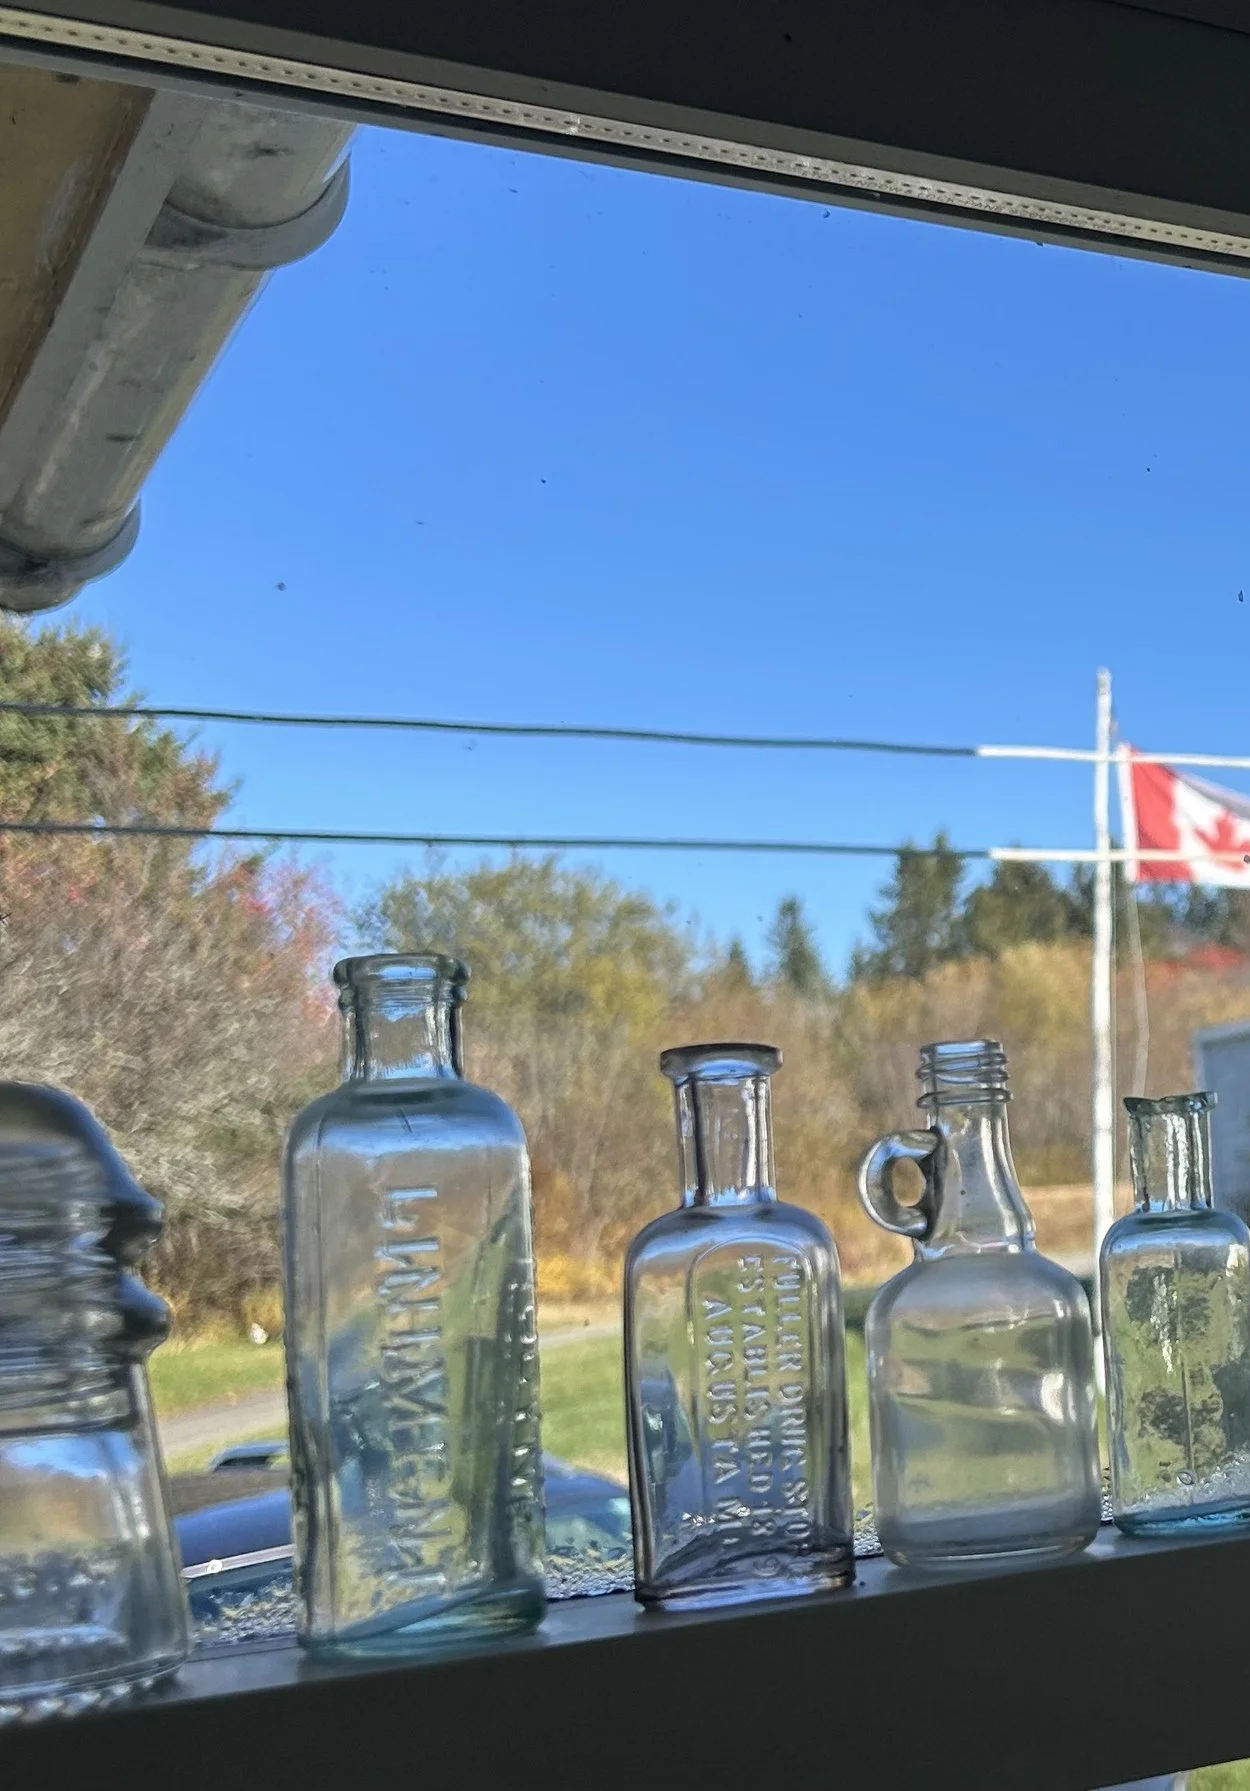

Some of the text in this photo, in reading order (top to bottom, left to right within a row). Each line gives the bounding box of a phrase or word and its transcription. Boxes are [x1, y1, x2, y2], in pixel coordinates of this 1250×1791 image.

[771, 1253, 804, 1371] FULLER
[702, 1298, 742, 1485] AUGUSTA
[736, 1254, 781, 1578] ESTABLISHED 189
[777, 1382, 808, 1472] DRUG
